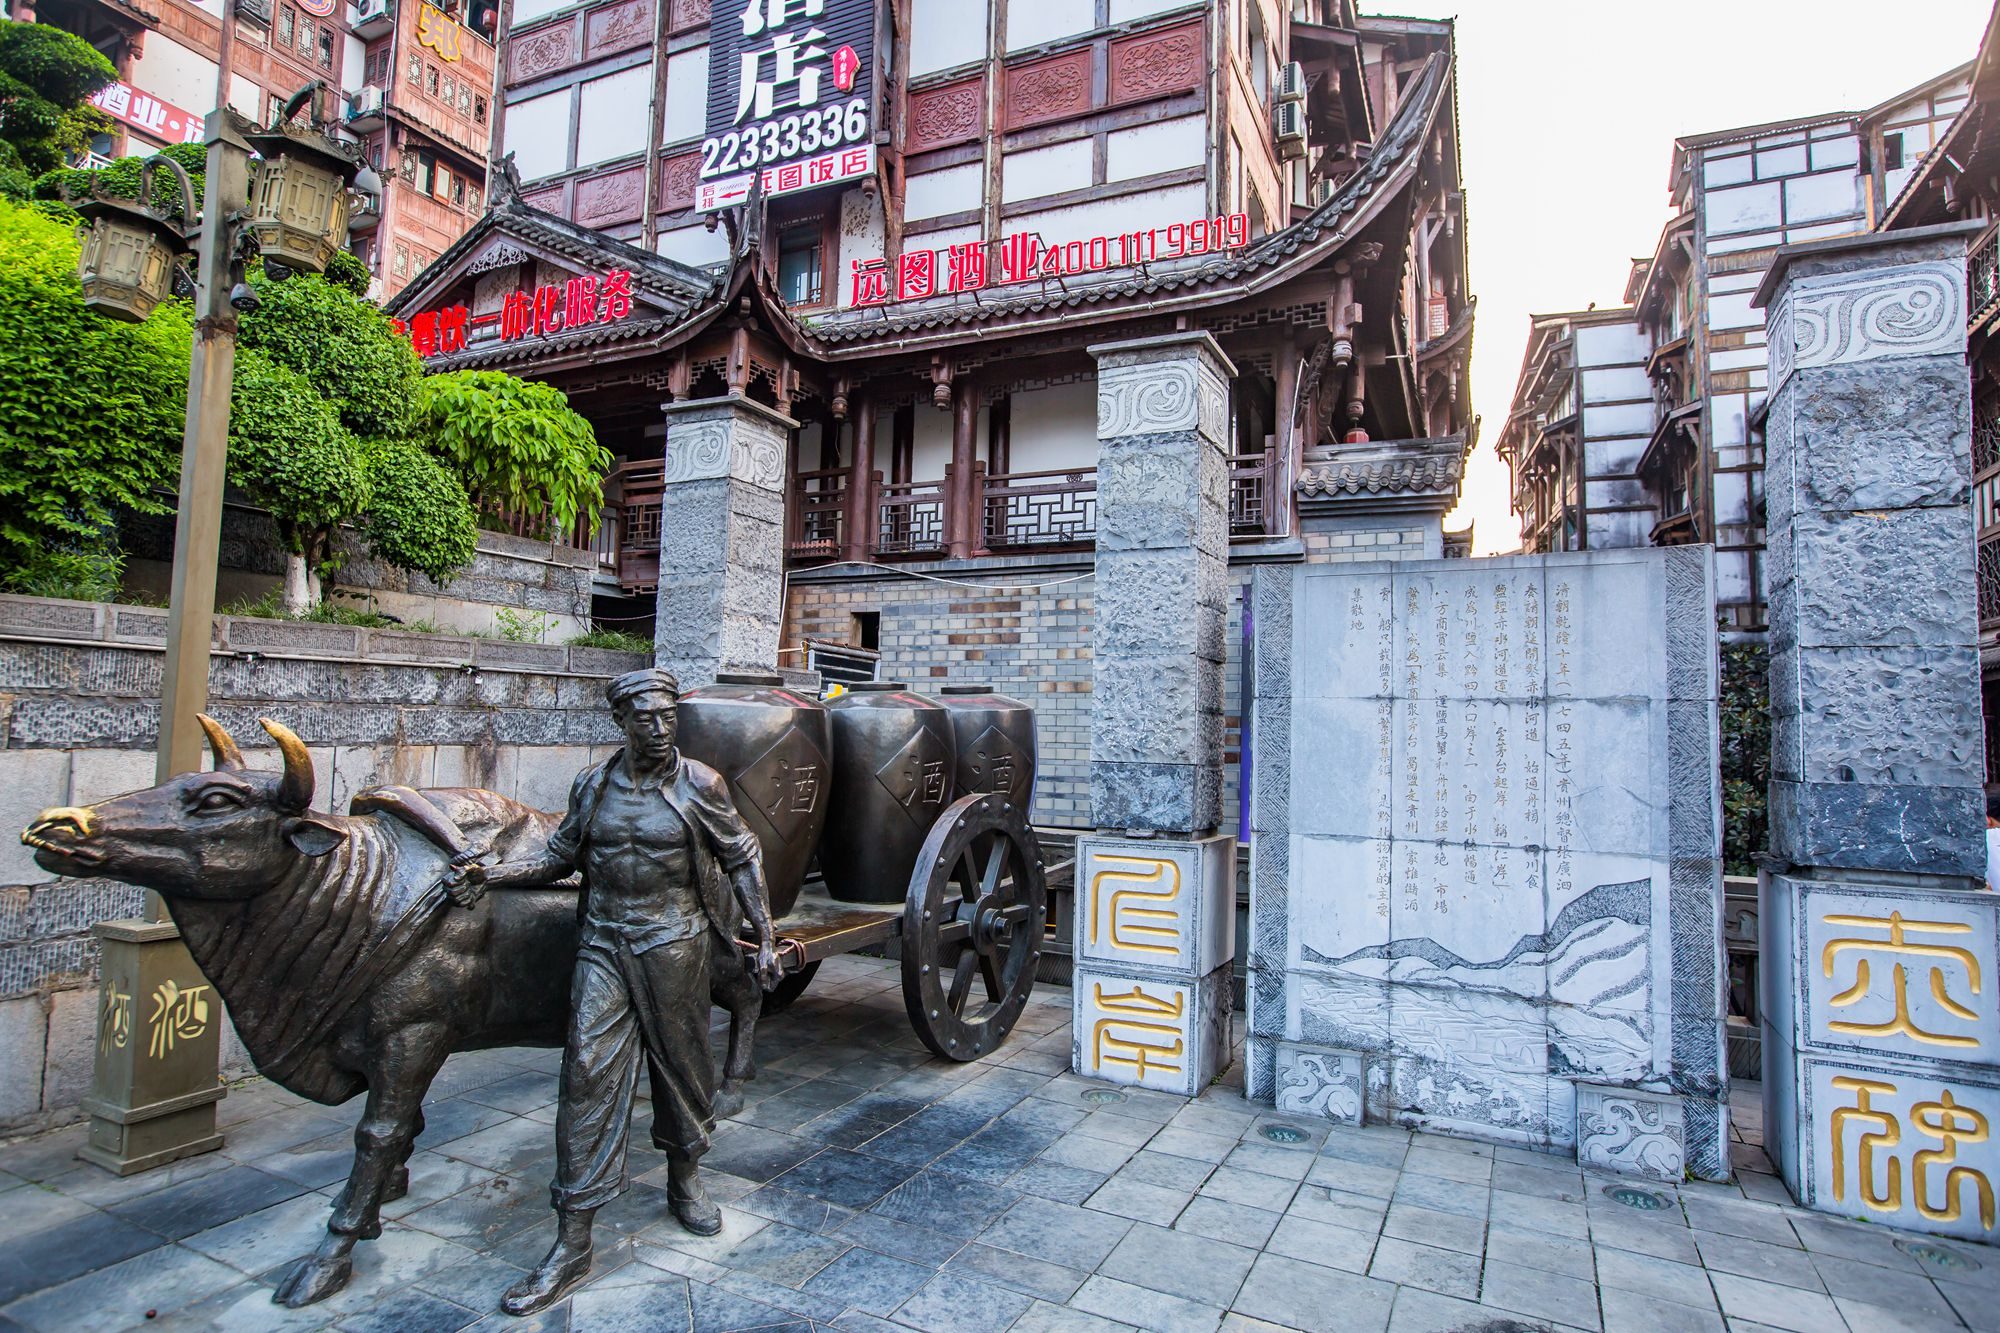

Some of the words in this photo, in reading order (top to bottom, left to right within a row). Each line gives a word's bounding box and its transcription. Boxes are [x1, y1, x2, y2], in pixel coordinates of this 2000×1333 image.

[417, 4, 461, 62] 郑
[700, 98, 868, 179] 22333336
[850, 231, 1039, 308] 远图酒业
[1041, 212, 1249, 276] 4001119919
[766, 758, 820, 815] 酒
[900, 754, 946, 807] 酒
[970, 751, 1016, 795] 酒
